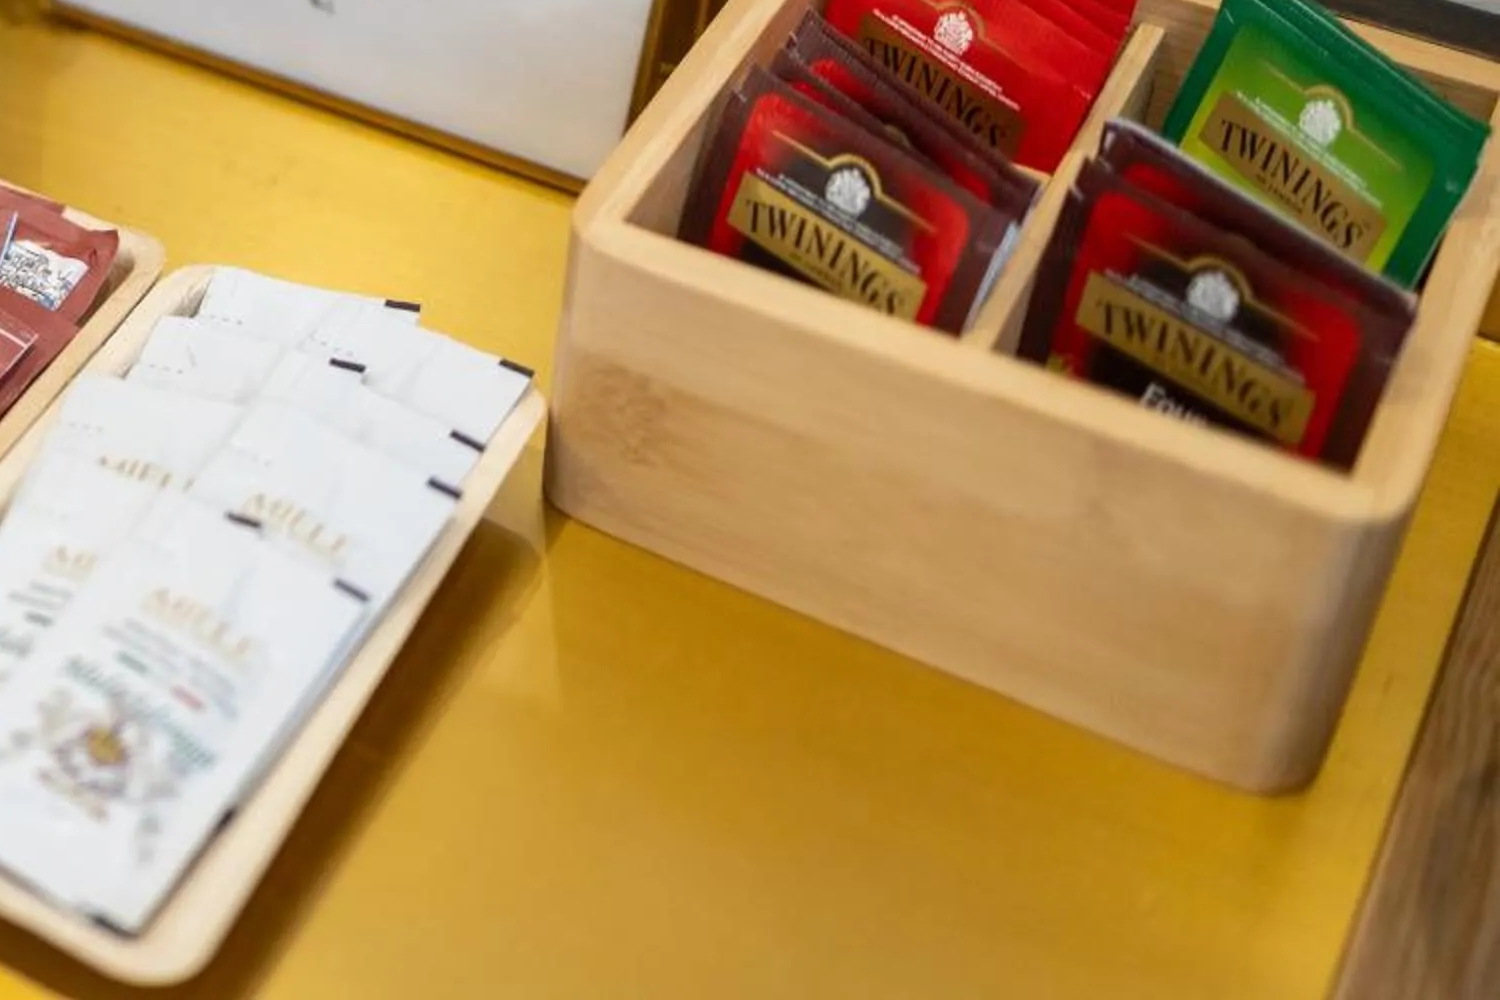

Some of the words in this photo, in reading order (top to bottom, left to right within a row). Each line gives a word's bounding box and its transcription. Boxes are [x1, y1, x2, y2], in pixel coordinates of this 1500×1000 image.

[863, 35, 1009, 148] TWININGS
[1221, 118, 1365, 249] TWININGS
[745, 199, 904, 317] TWININGS
[1095, 298, 1291, 430] TWININGS
